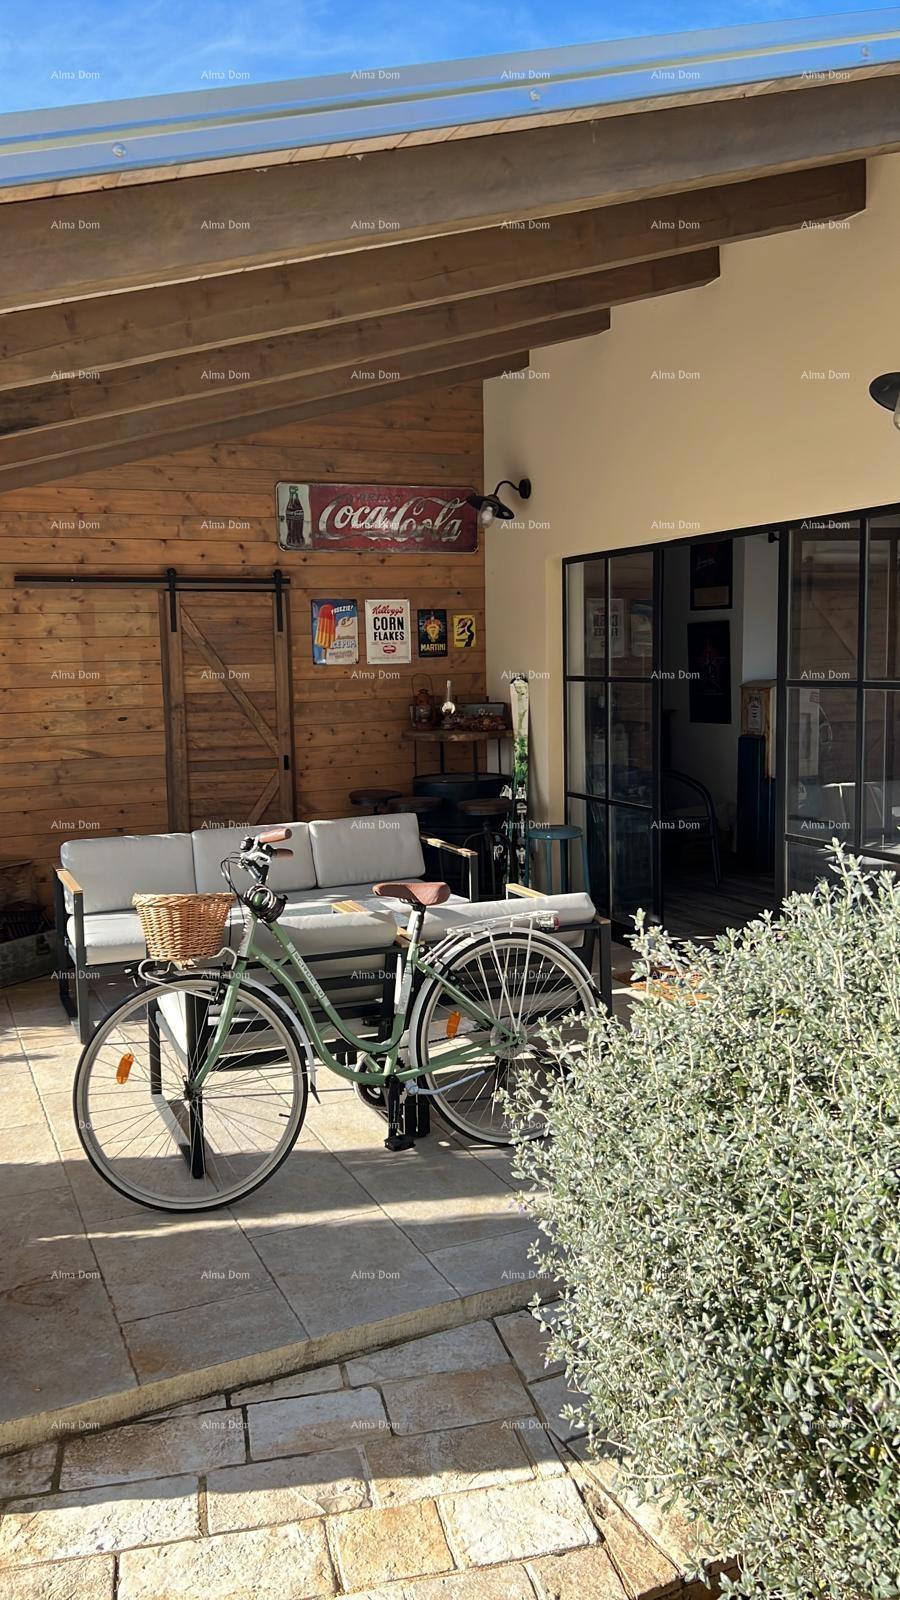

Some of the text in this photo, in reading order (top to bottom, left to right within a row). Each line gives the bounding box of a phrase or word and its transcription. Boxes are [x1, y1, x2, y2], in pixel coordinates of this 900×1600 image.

[318, 495, 467, 542] Coca-Cola
[372, 604, 404, 616] Kellogg's
[373, 616, 404, 631] CORN
[373, 631, 405, 641] FLAKES
[420, 643, 446, 652] MARTINI
